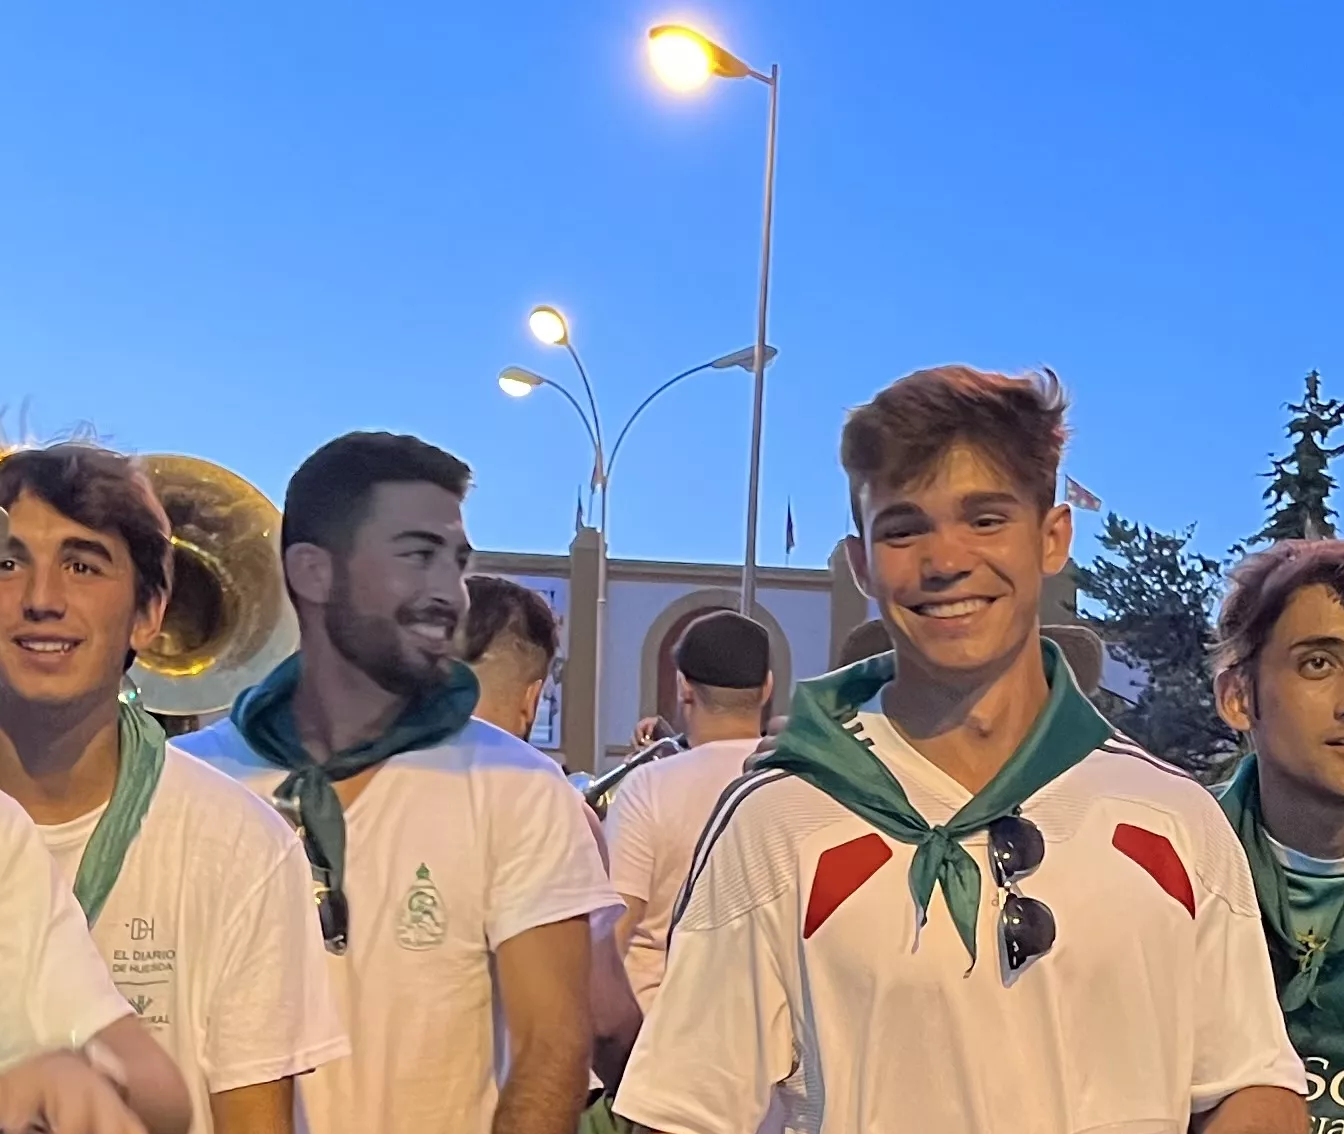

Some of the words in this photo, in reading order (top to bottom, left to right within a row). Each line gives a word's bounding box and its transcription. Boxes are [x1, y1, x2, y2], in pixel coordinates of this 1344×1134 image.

[113, 949, 130, 961] EL
[132, 949, 176, 961] DIARIO
[112, 963, 127, 973] DE
